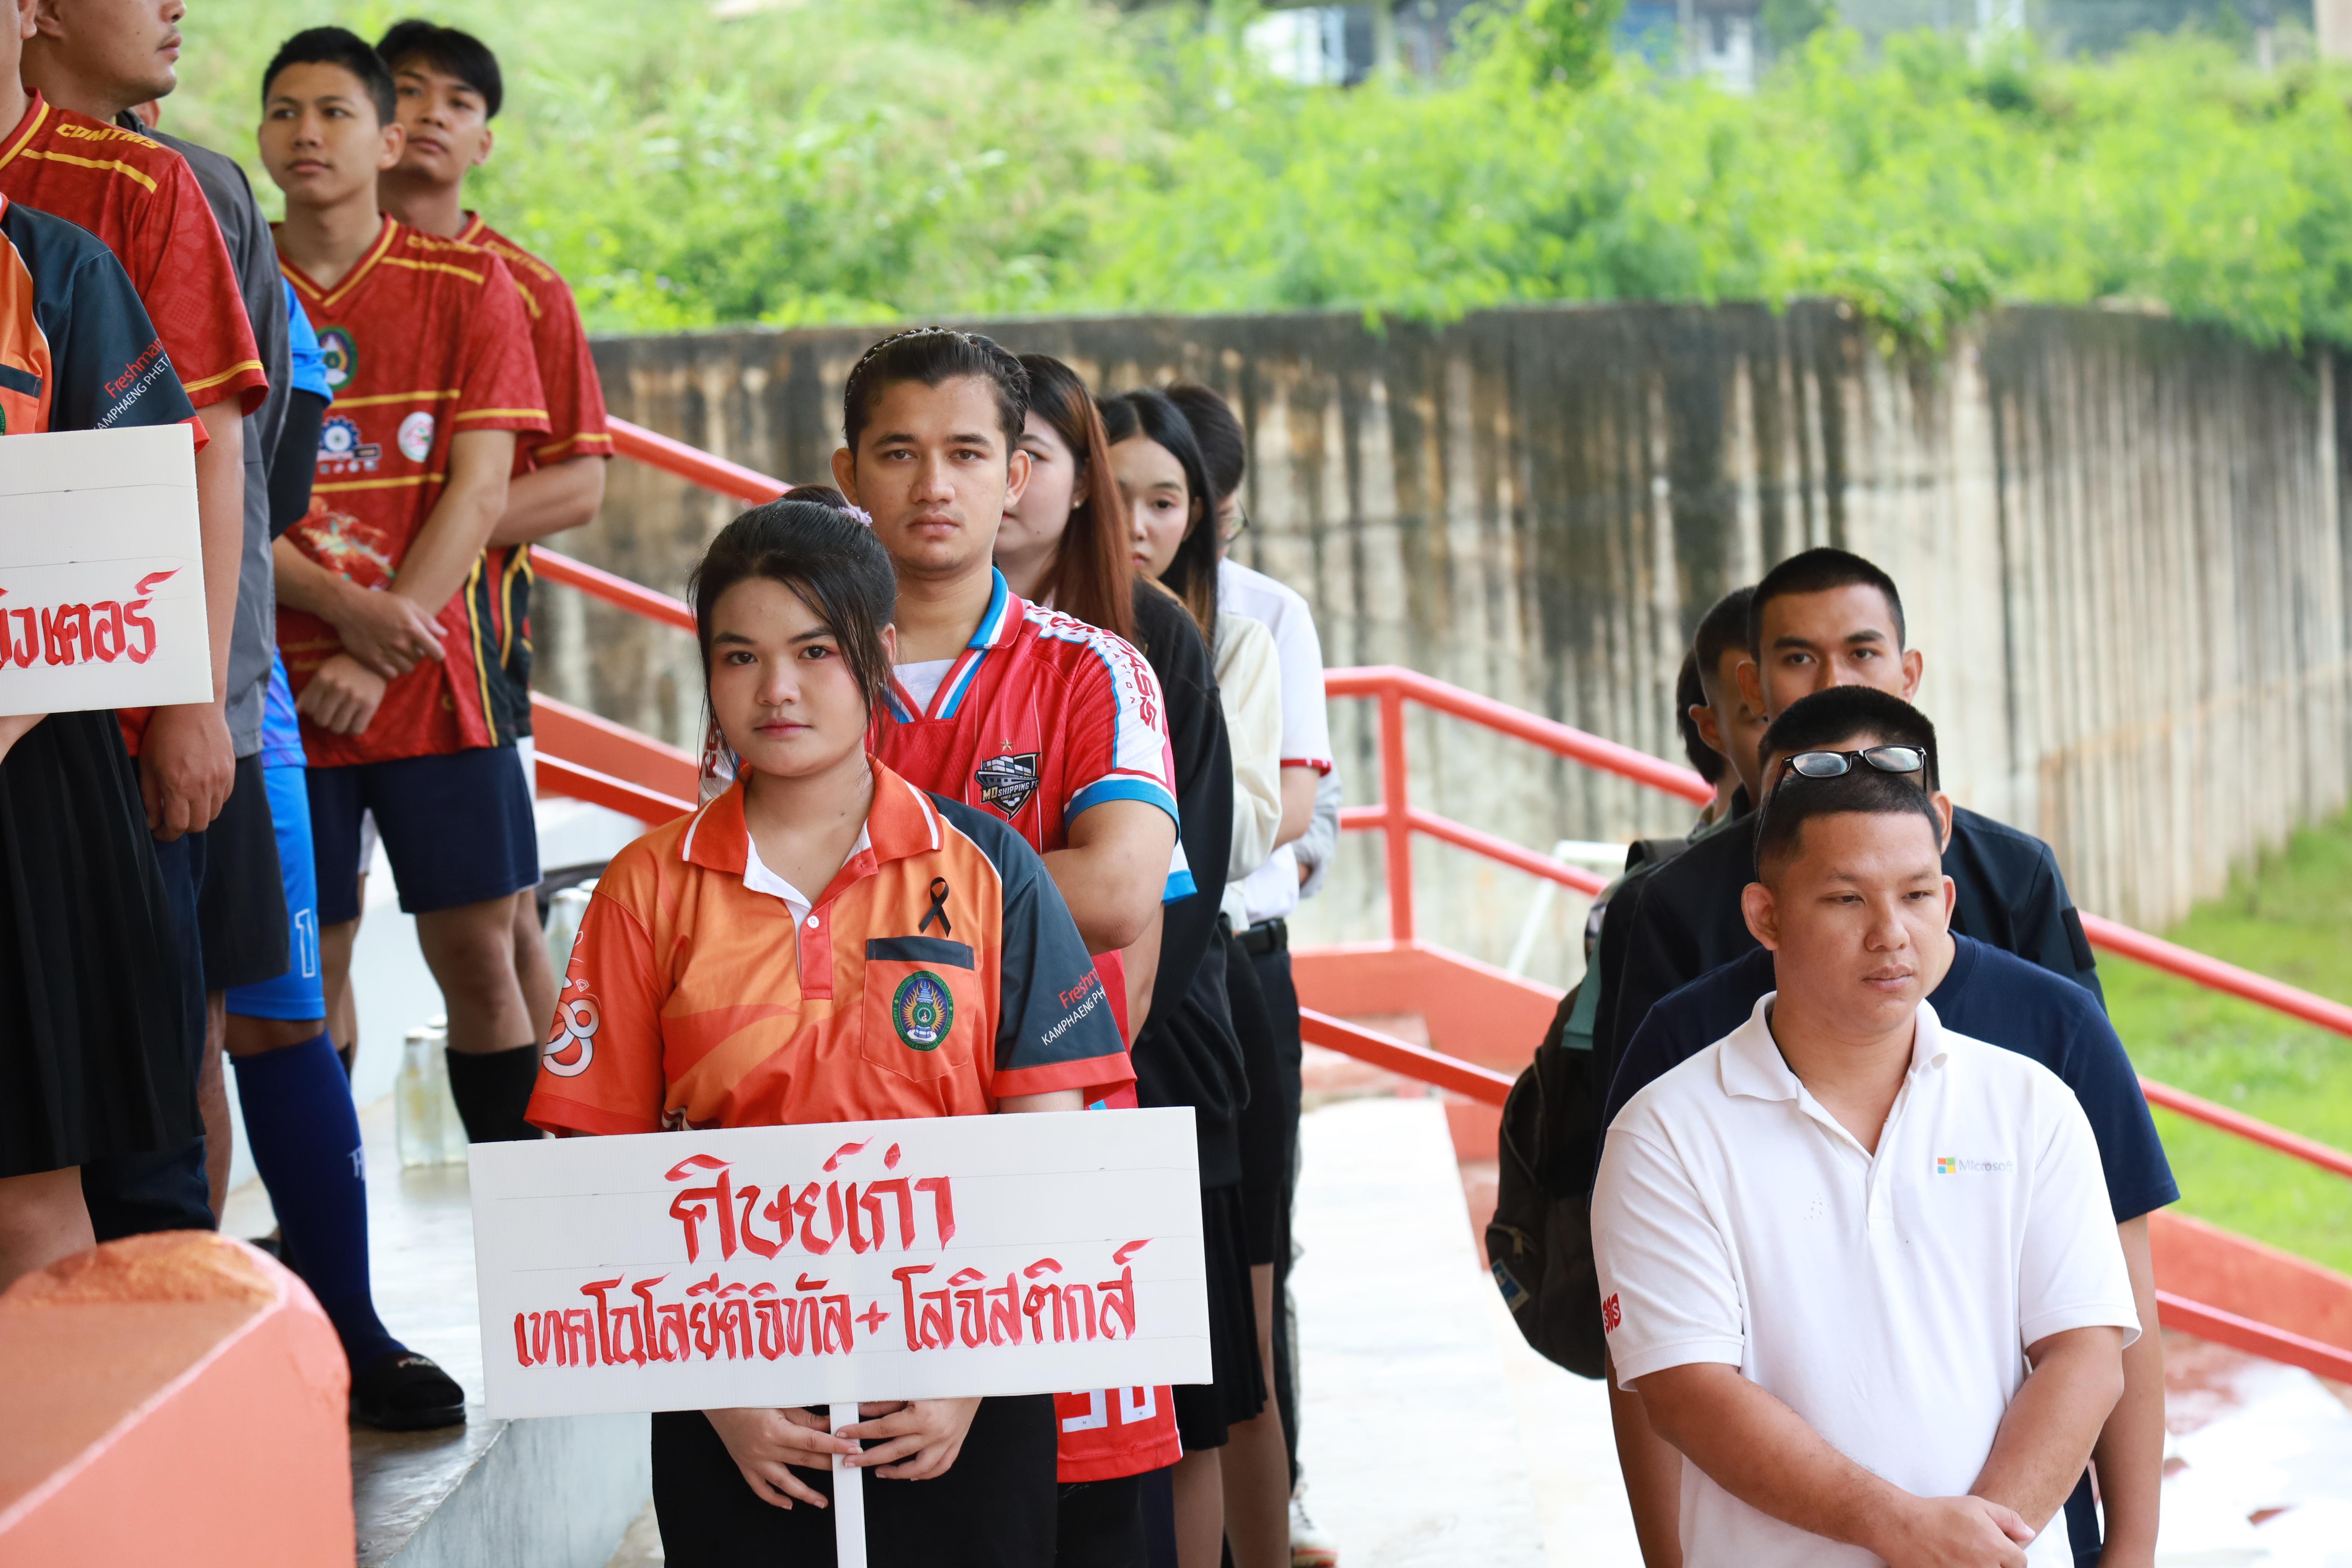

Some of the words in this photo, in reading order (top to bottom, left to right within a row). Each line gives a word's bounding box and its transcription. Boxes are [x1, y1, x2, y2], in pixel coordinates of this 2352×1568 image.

[143, 357, 168, 385] PHET
[0, 565, 184, 671] วเตอร์
[998, 782, 1030, 797] SHIPPING
[1041, 997, 1094, 1046] KAMPHAENG
[1092, 985, 1106, 1004] PH
[1959, 1159, 2013, 1172] Microsoft
[664, 1135, 956, 1265] ศิษย์เก่า
